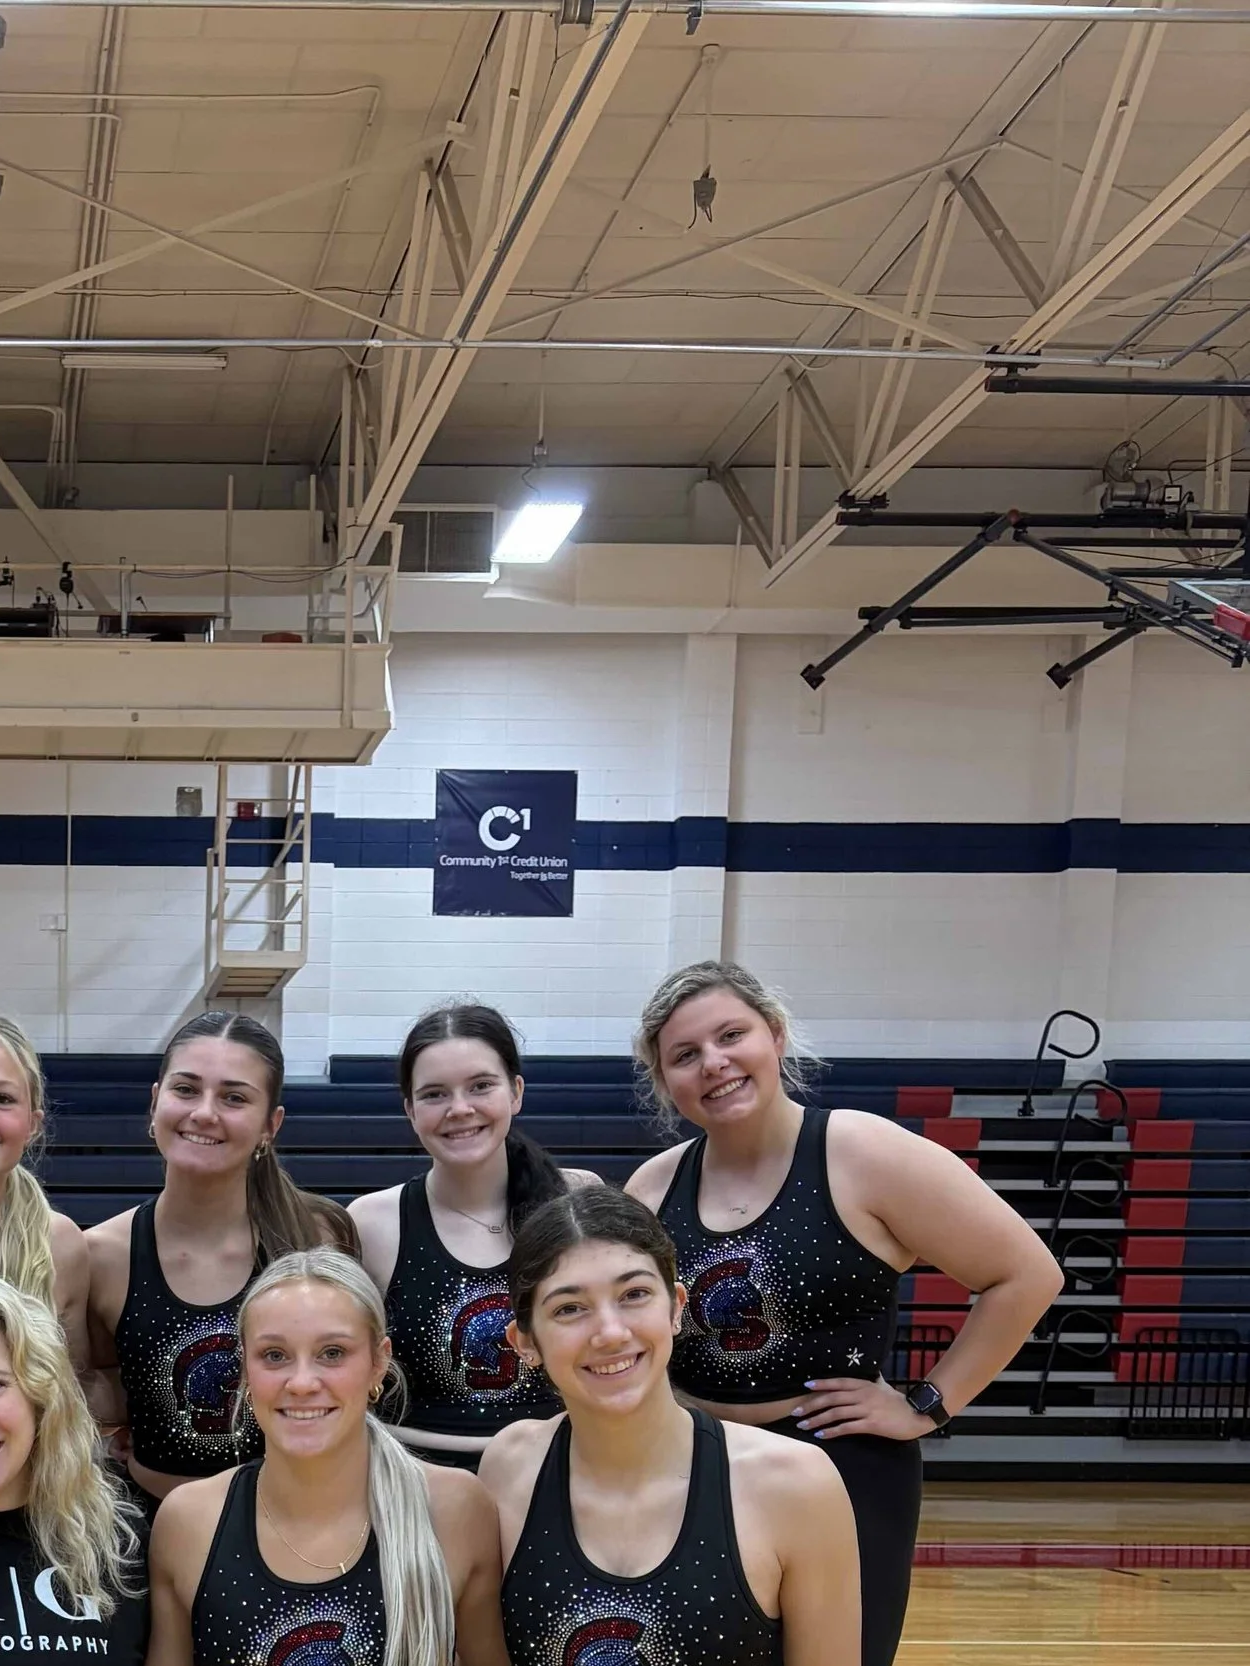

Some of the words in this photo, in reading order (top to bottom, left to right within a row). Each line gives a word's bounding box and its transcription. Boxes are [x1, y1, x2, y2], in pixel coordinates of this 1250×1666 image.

[439, 855, 496, 868] Community
[510, 855, 538, 867] Credit
[539, 856, 567, 867] Union
[510, 871, 539, 881] Together
[547, 872, 568, 880] Better
